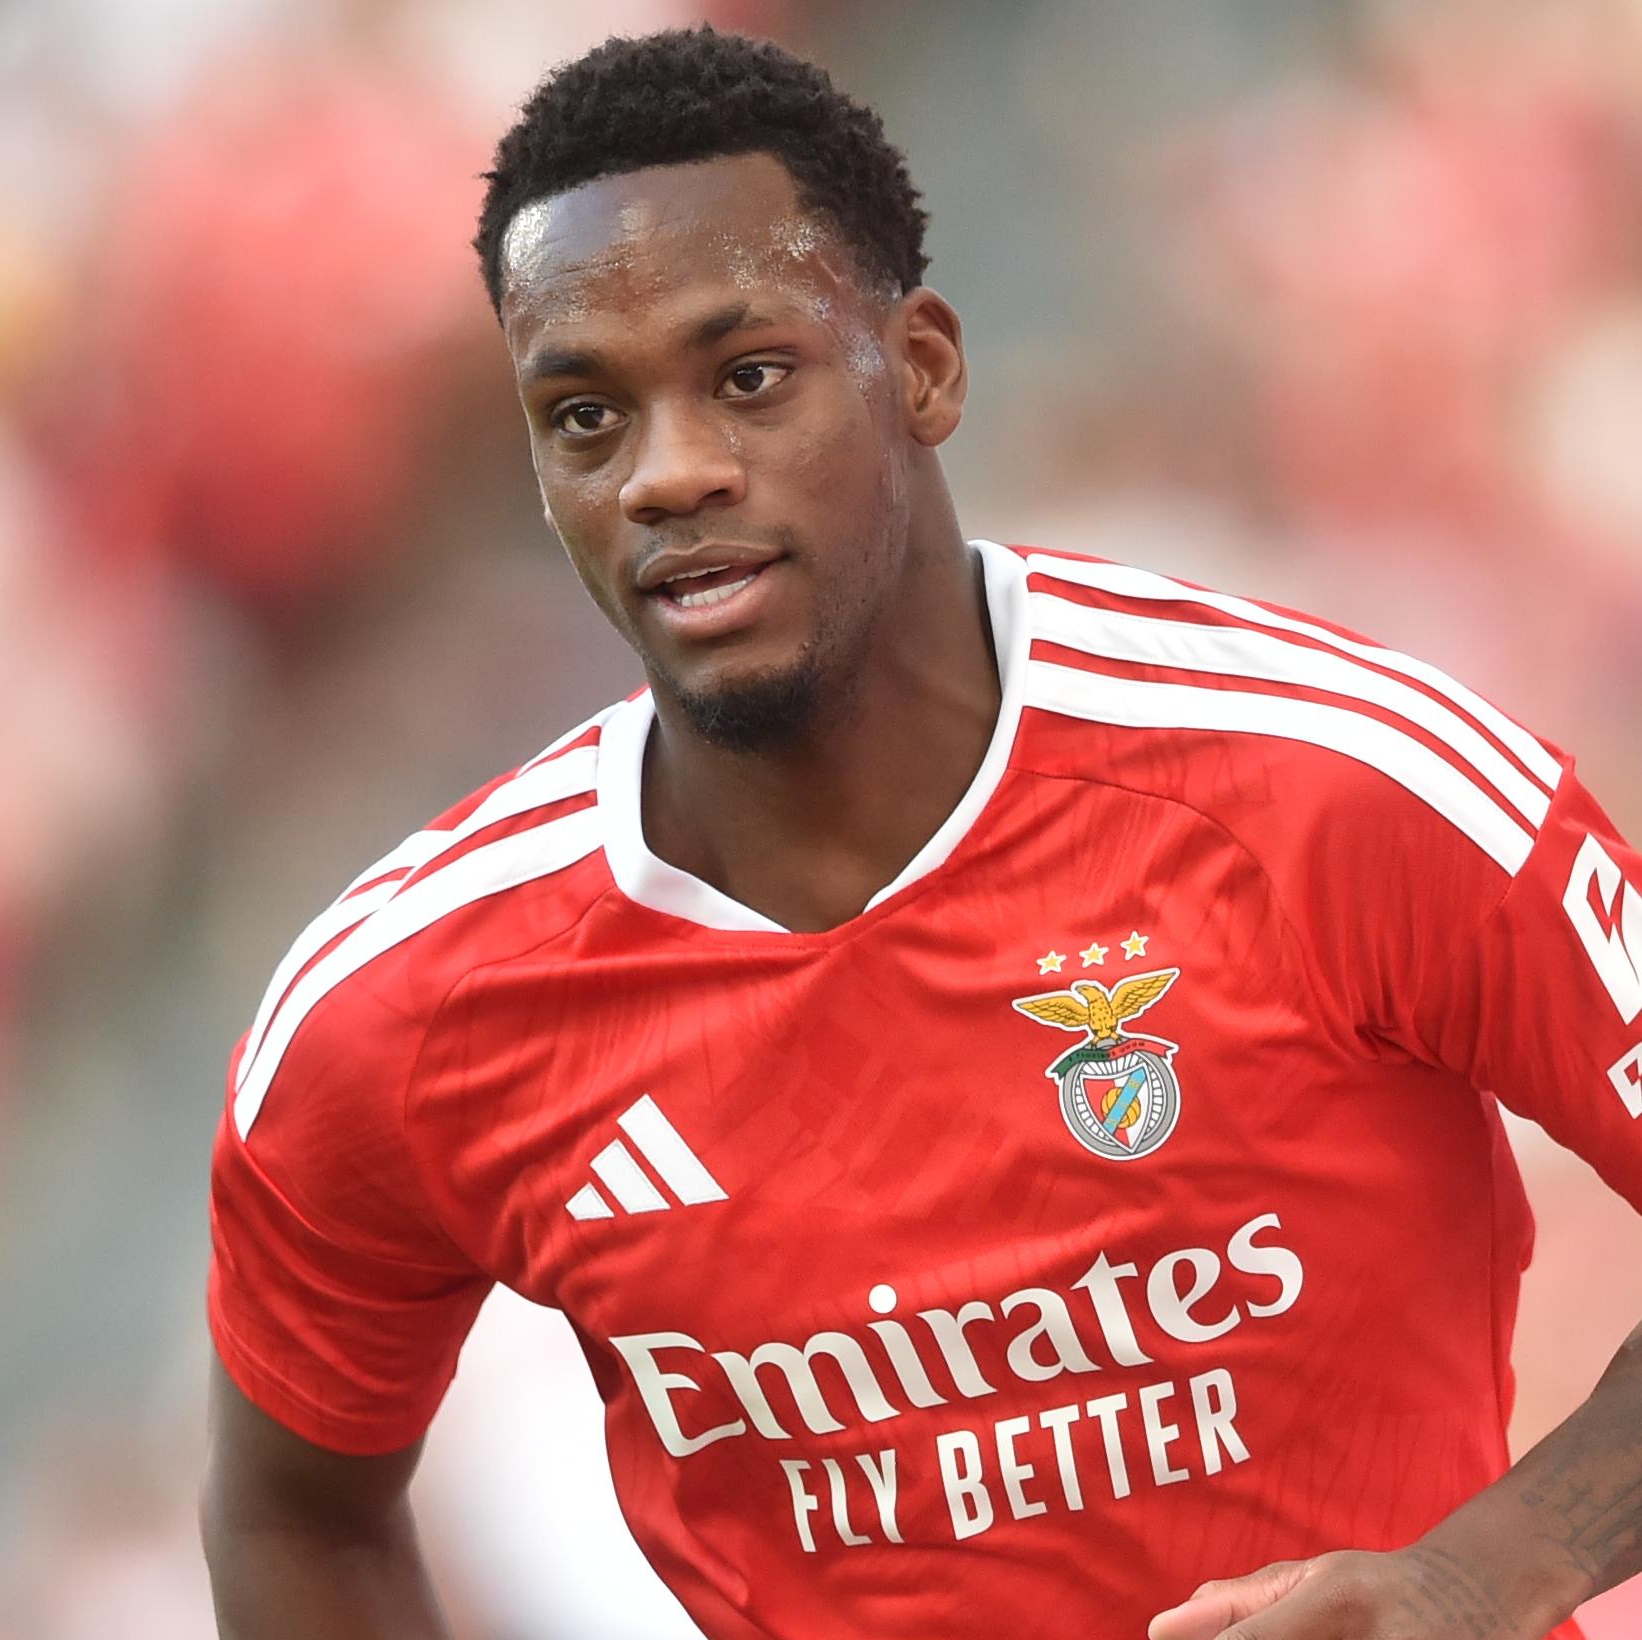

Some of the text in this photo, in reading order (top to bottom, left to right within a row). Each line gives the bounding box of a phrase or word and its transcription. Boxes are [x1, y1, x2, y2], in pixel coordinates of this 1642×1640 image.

[608, 1213, 1304, 1457] Emirates
[779, 1368, 1251, 1553] FLY BETTER
